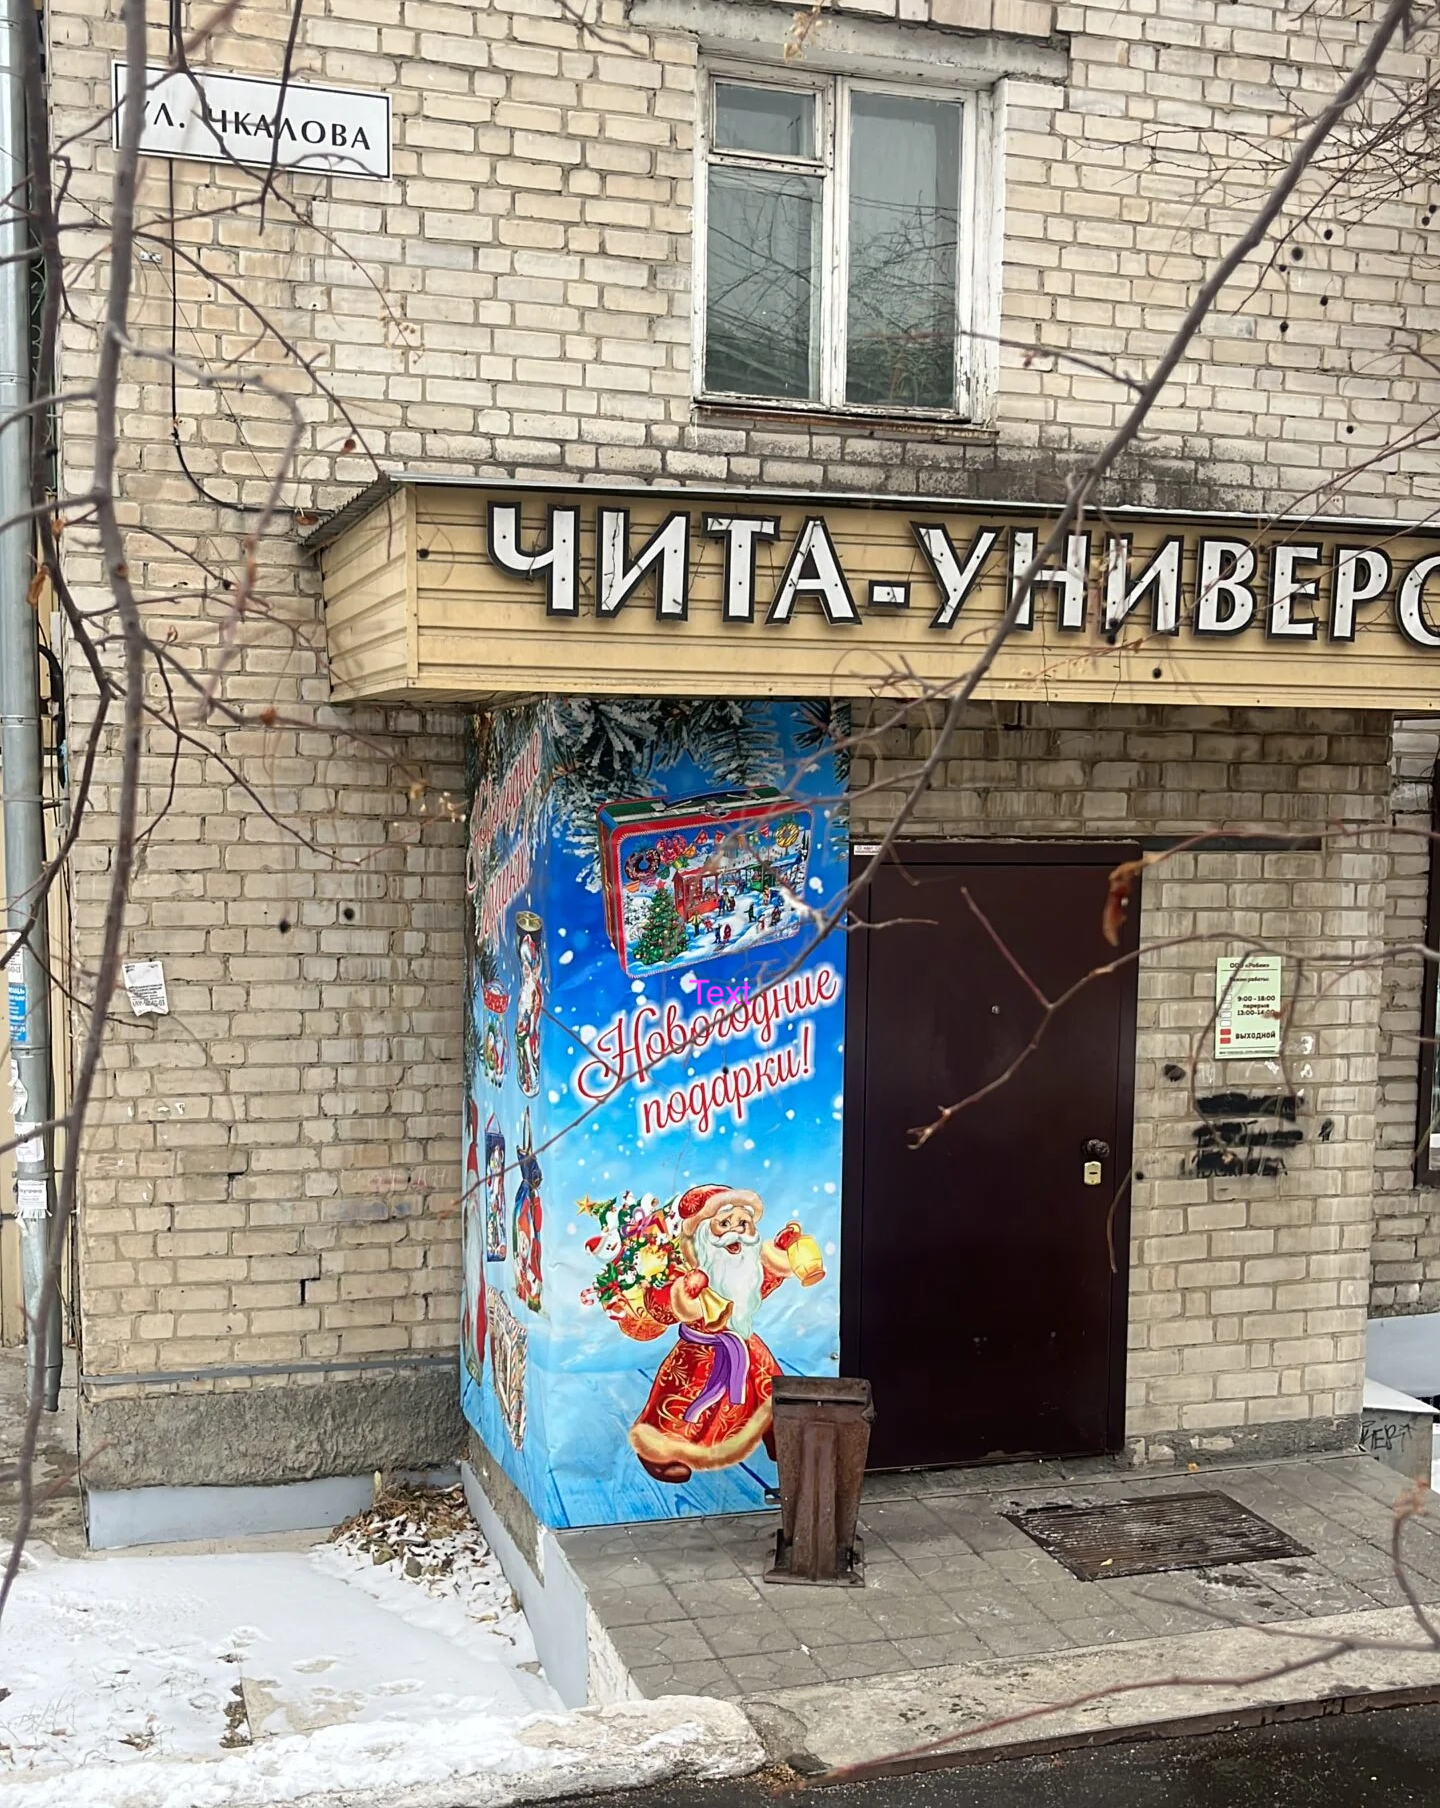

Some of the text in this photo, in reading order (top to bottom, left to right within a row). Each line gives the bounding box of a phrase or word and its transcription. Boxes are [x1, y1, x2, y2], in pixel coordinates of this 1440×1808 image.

[207, 107, 371, 150] ЧКАЛОВА
[577, 969, 837, 1099] Новогодние
[1235, 1031, 1276, 1040] ВЫХОДНОЙ
[643, 1025, 810, 1133] подарки!
